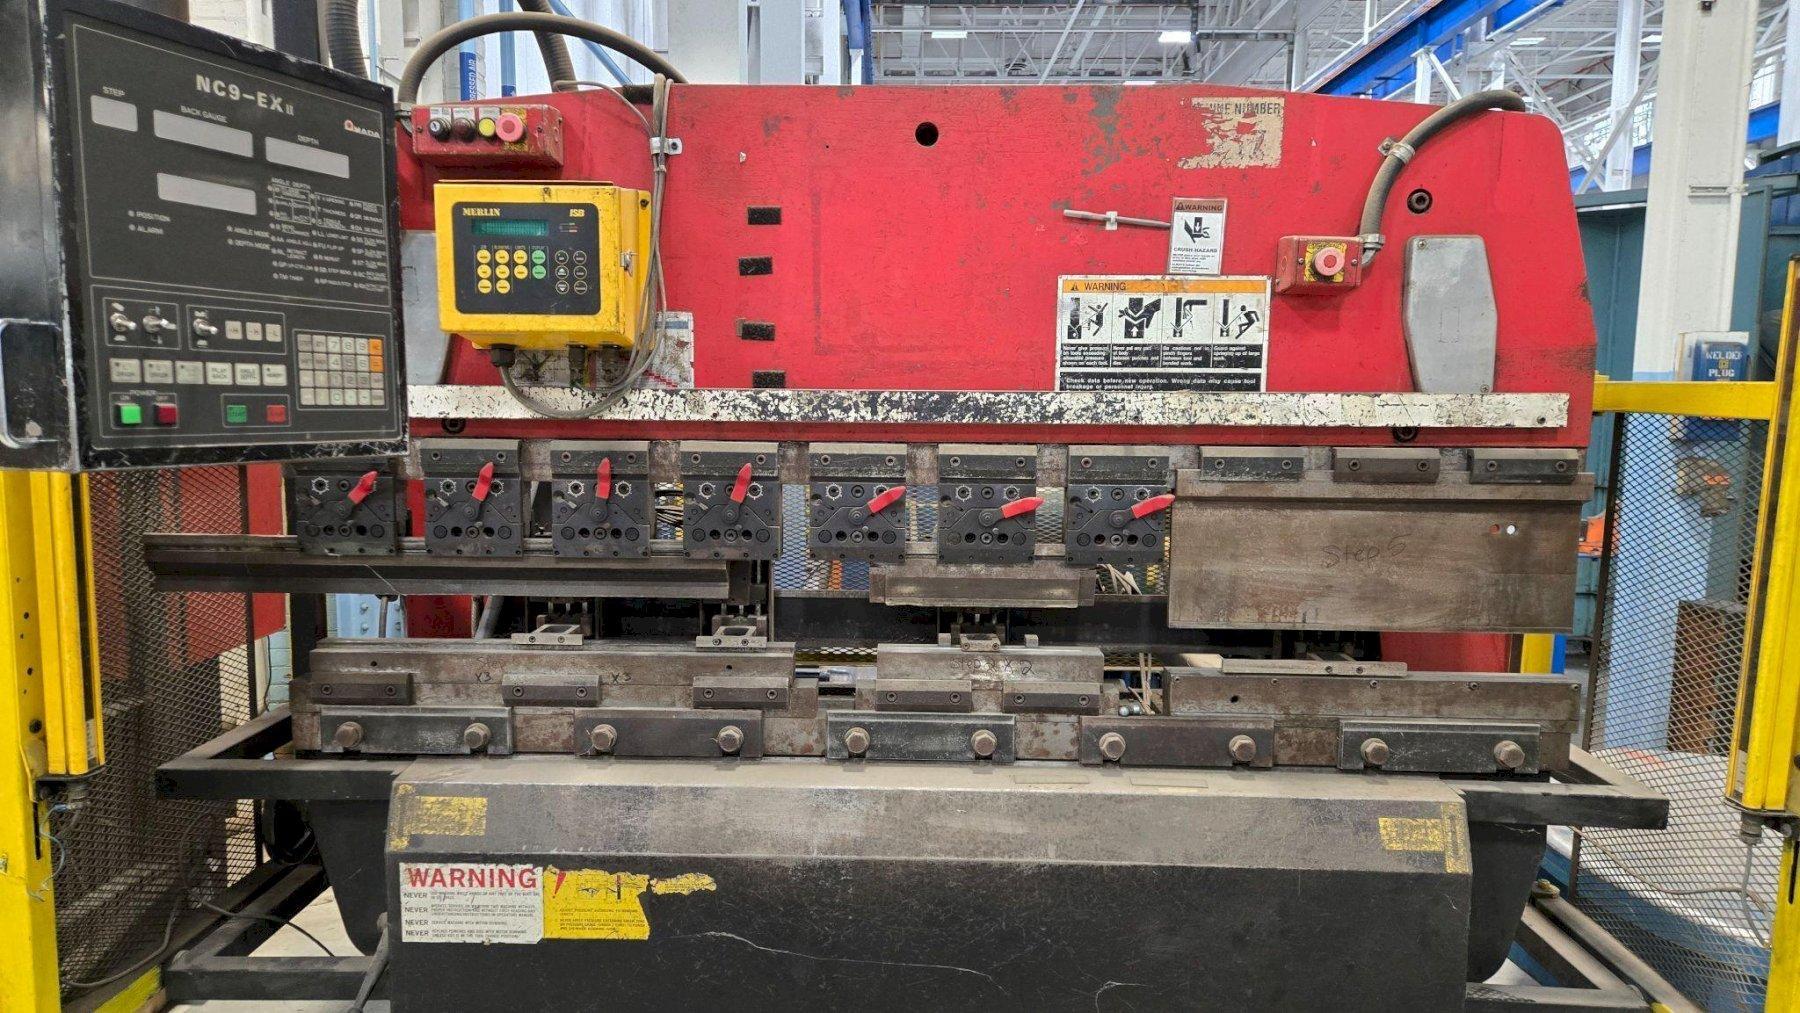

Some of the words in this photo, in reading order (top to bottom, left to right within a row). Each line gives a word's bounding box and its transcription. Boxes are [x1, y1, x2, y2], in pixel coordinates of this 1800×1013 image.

[462, 207, 501, 217] MERLIN
[1084, 282, 1126, 291] WARNING
[1708, 368, 1735, 378] PLUG
[1321, 543, 1380, 569] Step
[406, 867, 538, 889] WARNING
